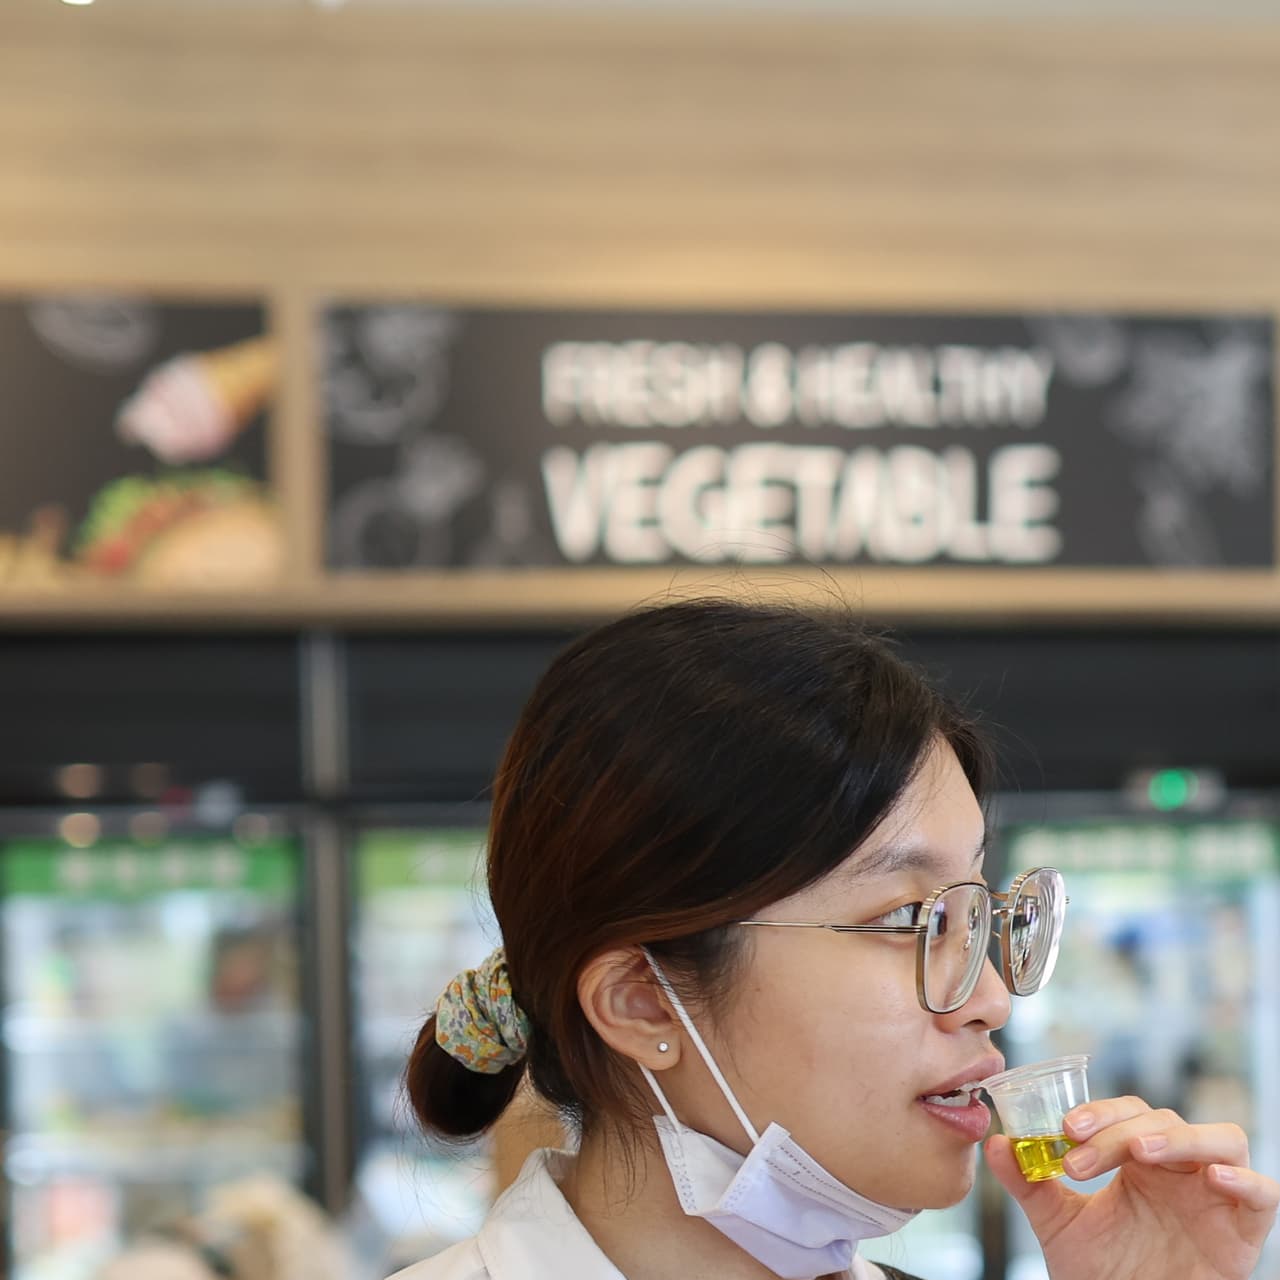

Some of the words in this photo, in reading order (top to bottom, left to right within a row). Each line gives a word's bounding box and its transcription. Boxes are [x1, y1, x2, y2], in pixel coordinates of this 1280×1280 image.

[541, 340, 745, 427] FRESH
[797, 341, 1052, 428] HEALTHY
[541, 441, 1062, 563] VEGETABLE
